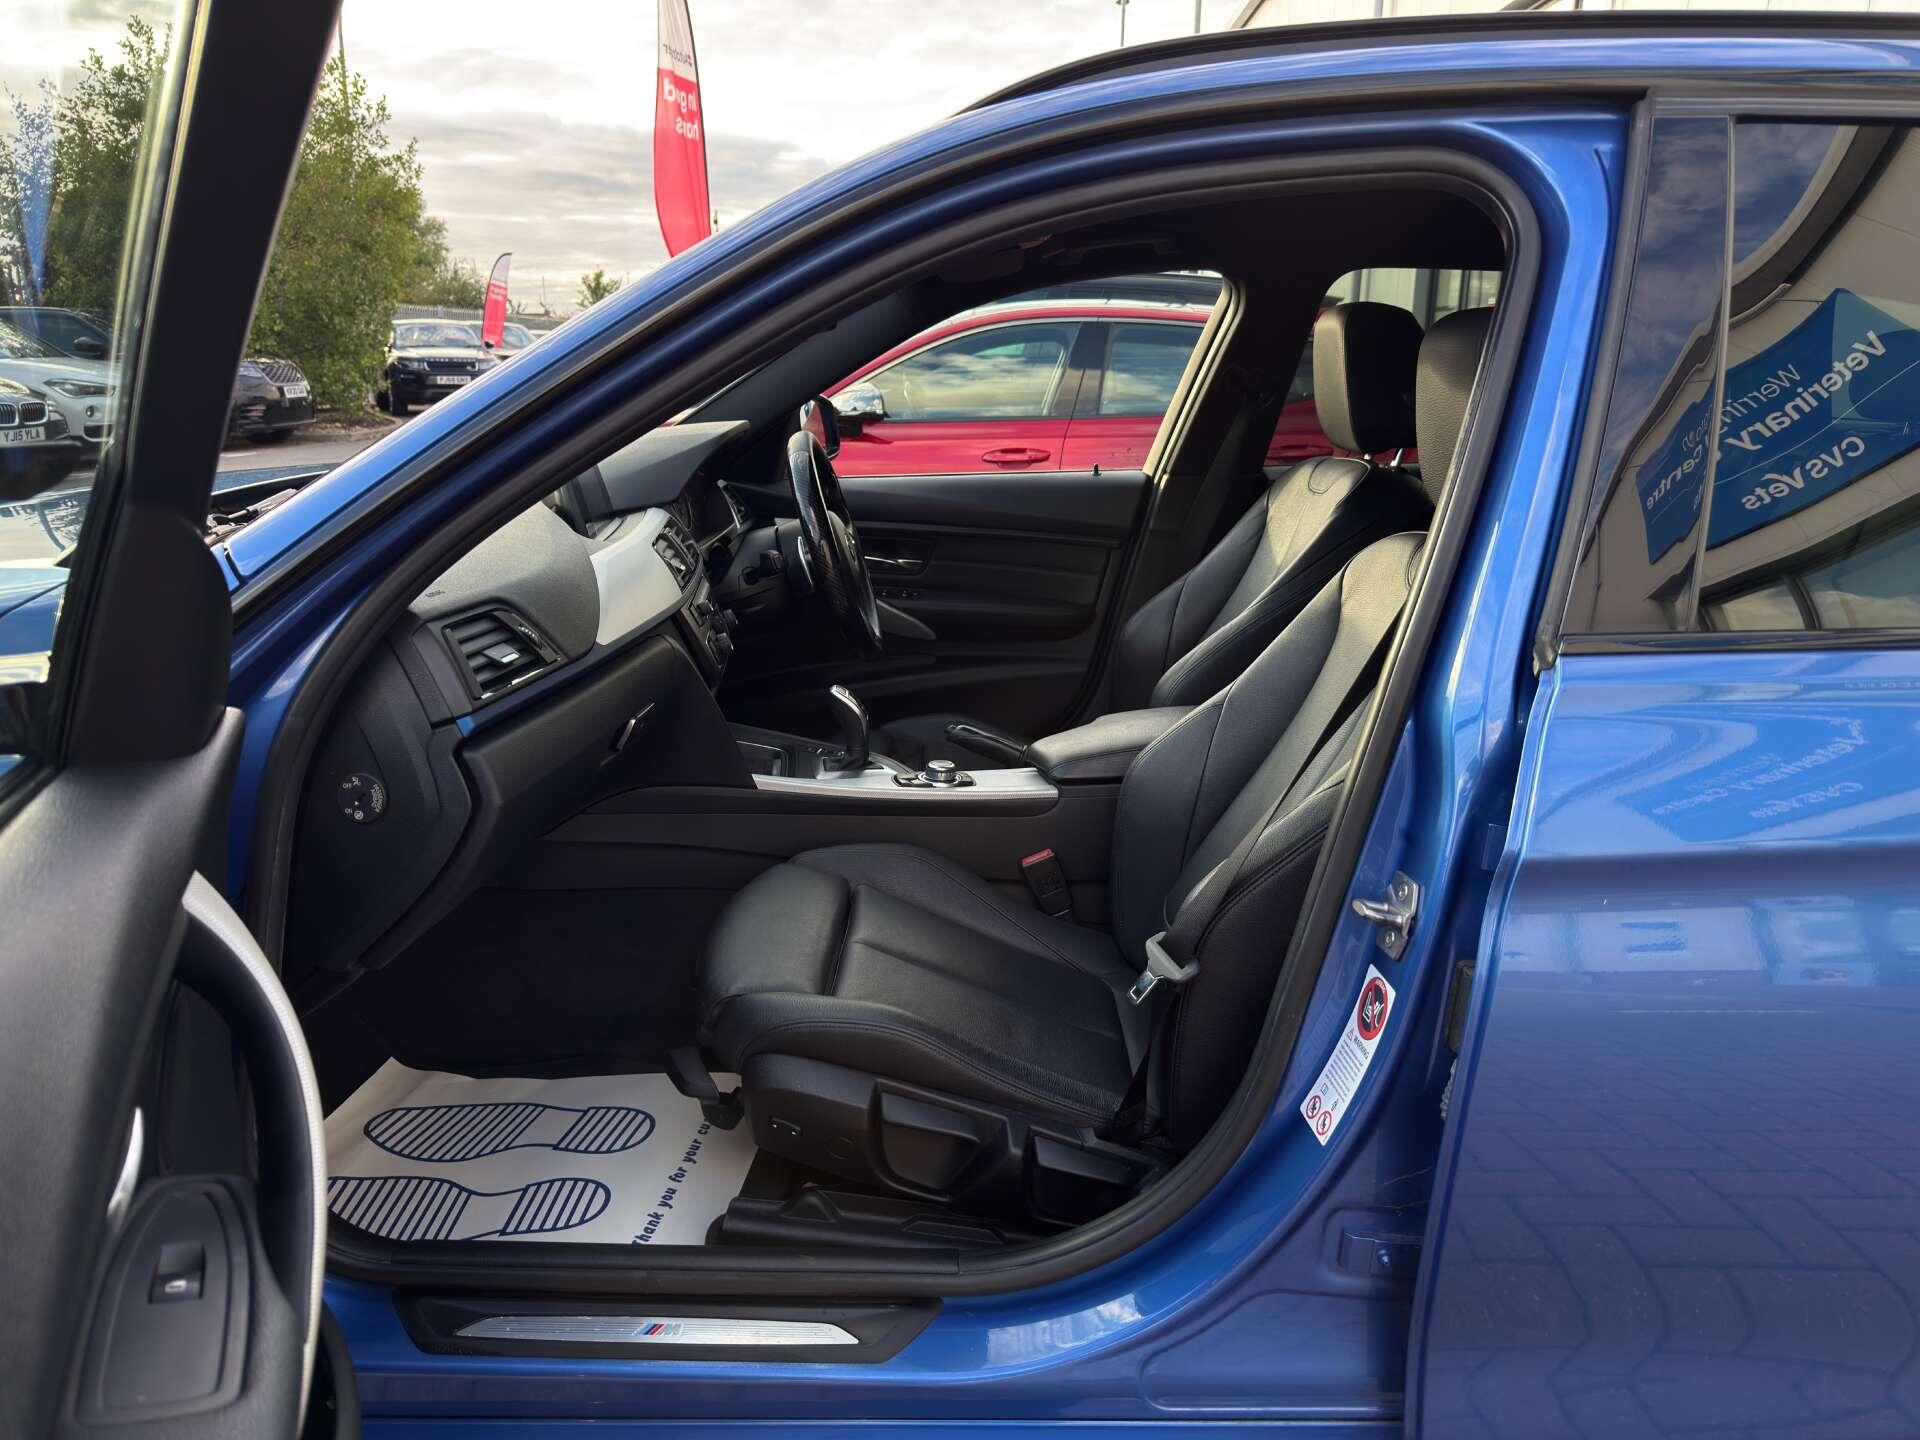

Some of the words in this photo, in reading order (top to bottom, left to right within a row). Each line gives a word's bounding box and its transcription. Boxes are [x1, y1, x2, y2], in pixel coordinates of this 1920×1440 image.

[657, 1187, 678, 1209] you
[668, 1166, 687, 1183] for
[682, 1138, 703, 1164] your
